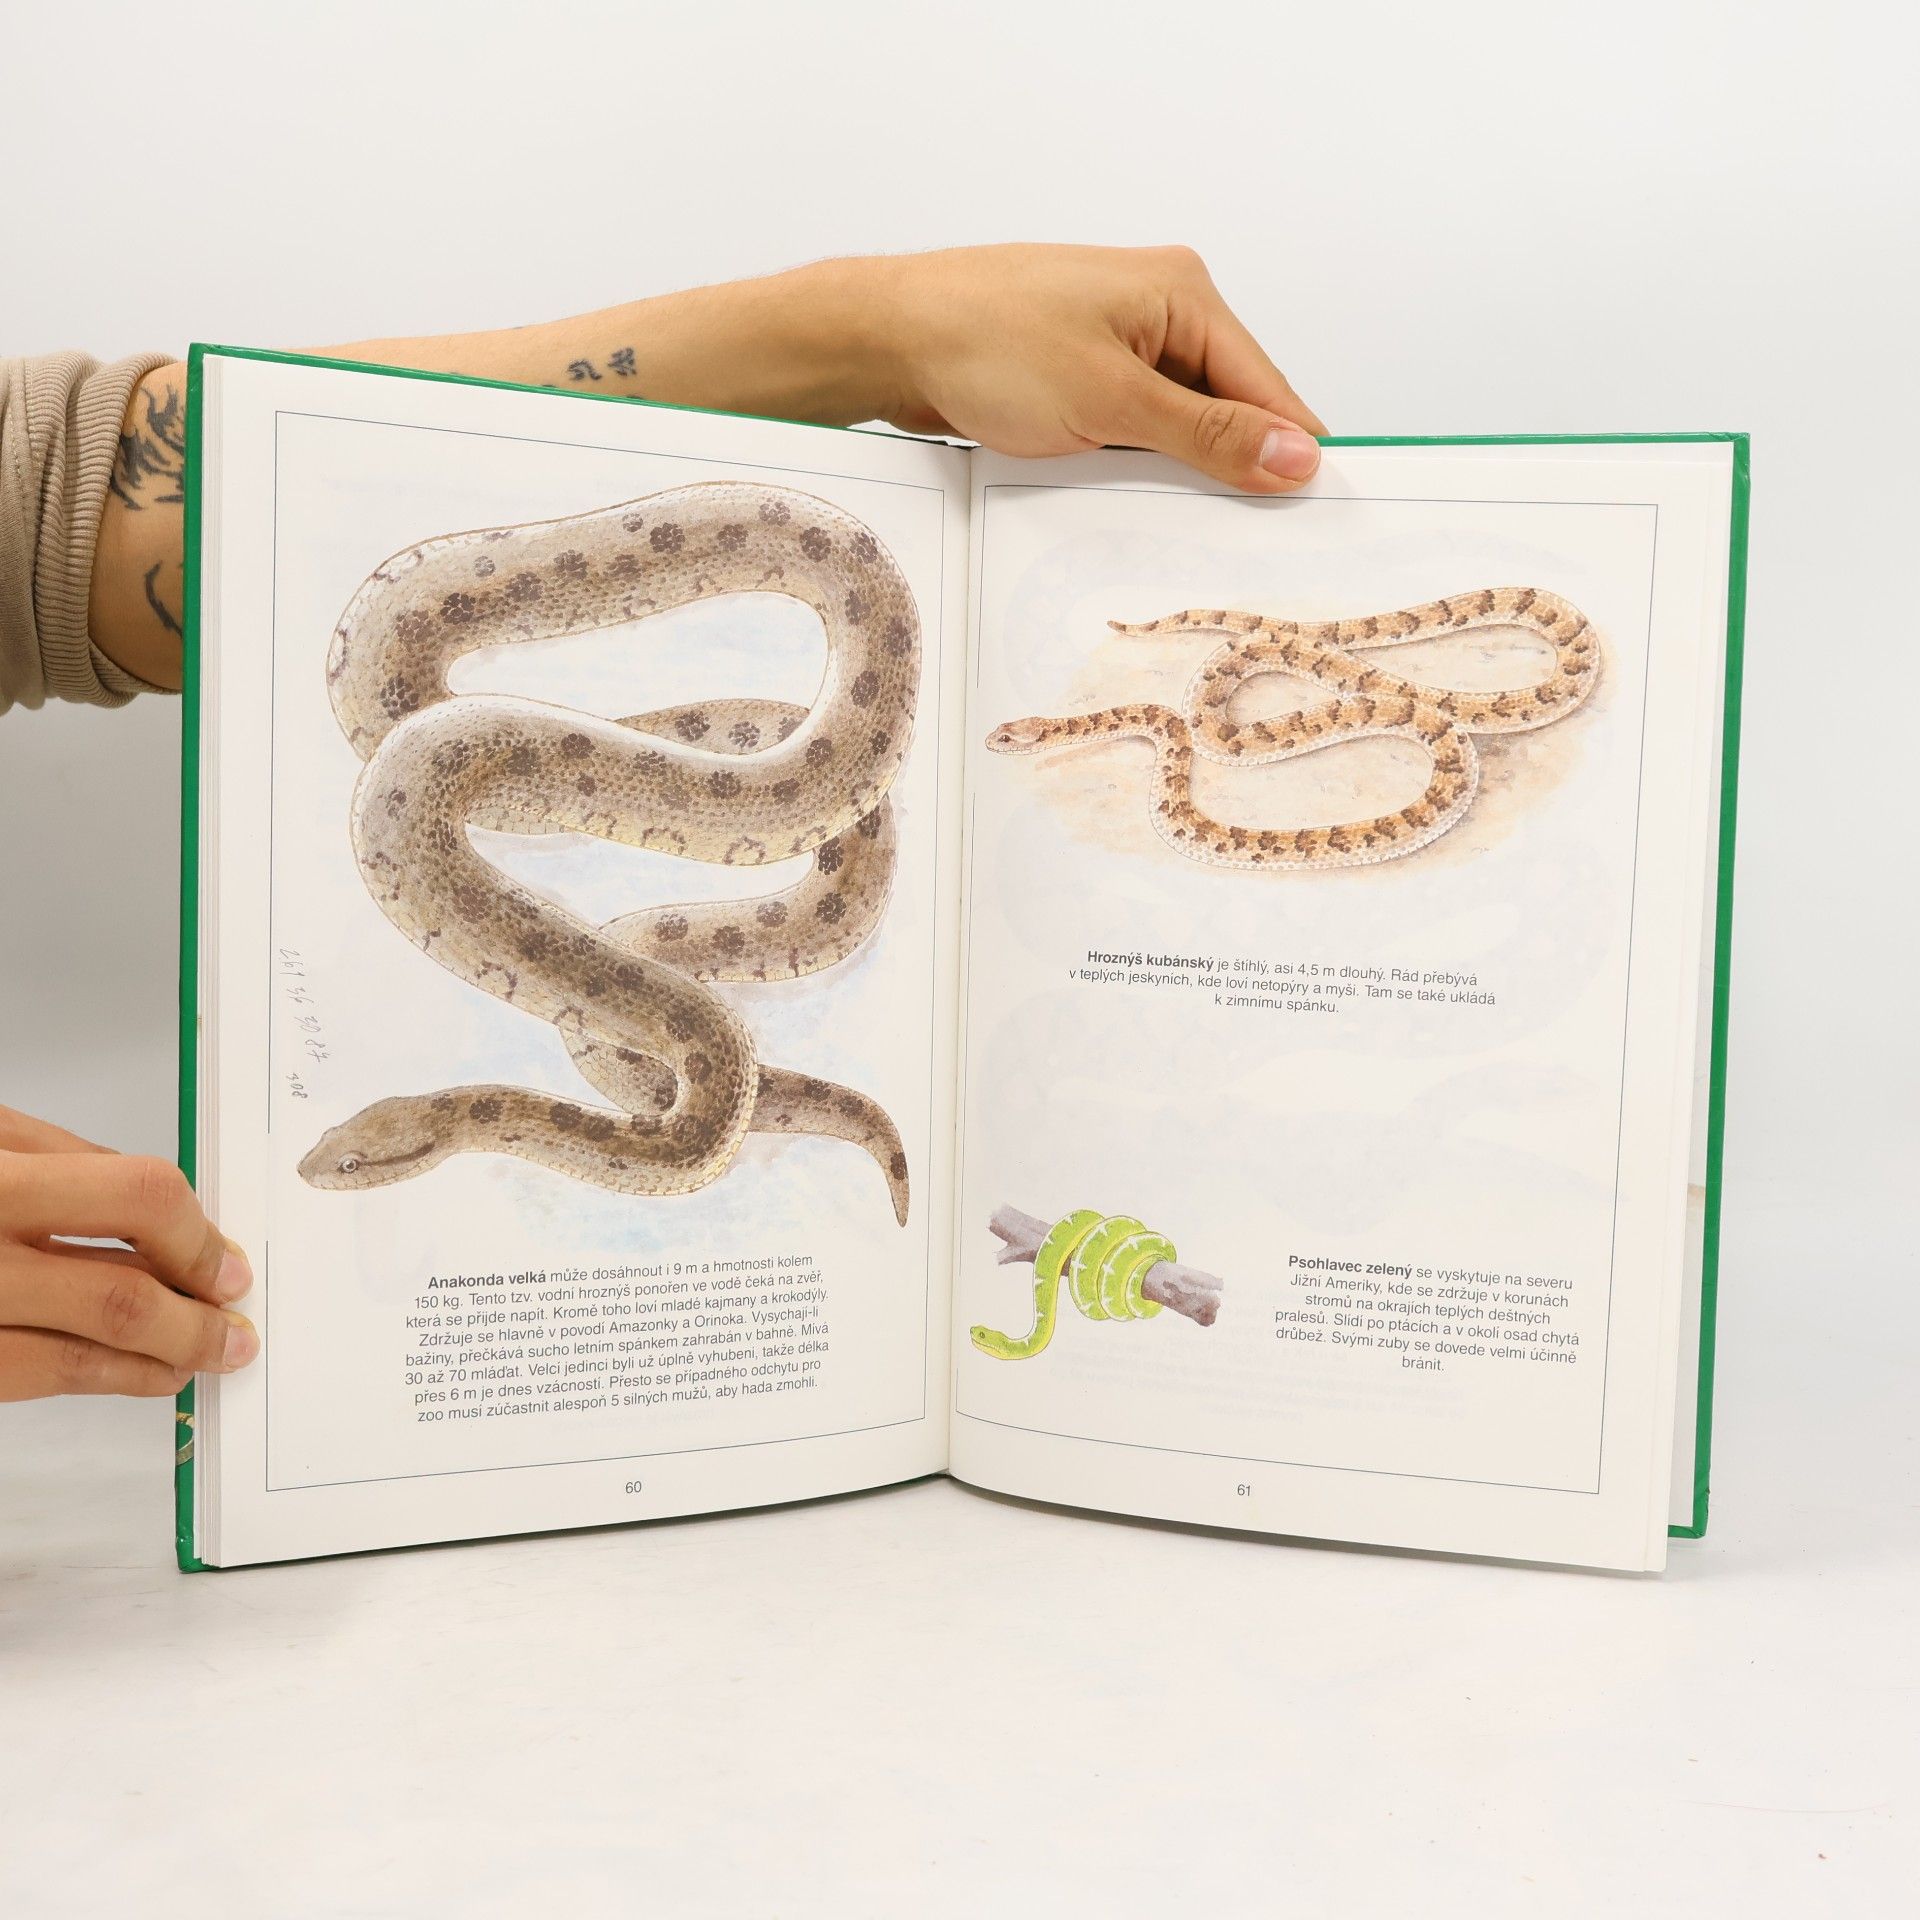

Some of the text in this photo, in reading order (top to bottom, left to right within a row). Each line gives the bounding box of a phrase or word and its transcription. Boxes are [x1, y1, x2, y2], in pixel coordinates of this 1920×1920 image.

[1069, 968, 1496, 1005] v teplých jeskyních, kde loví netopýry a myši. Tam se také ukládá
[1088, 950, 1477, 988] Hroznýš kubánský je štíhlý, asi 4,5 m dlouhý. Rád přebývá
[1215, 993, 1339, 1013] k zimnímu spánku.
[415, 1270, 823, 1310] 150 kg. Tento tzv. vodní hroznýš ponořen ve vodě čeká na zvěř,
[427, 1255, 813, 1289] Anakonda velká může dosáhnout i 9 m a hmotnosti kolem
[1288, 1255, 1573, 1290] Psohlavec zelený se vyskytuje na severu
[1290, 1273, 1568, 1307] Jižní Ameriky, kde se zdržuje v korunách
[406, 1288, 828, 1328] která se přijde napít. Kromě toho loví mladé kajmany a krokodýly.
[419, 1306, 818, 1347] Zdržuje se hlavně v povodí Amazonky a Orinoka. Vysychají-li
[1305, 1294, 1550, 1326] stromů na okrajích teplých deštných
[406, 1321, 829, 1367] bažiny, přečkává sucho letním spánkem zahrabán v bahně. Mívá
[1275, 1310, 1579, 1347] pralesů. Slídí po ptácích a v okolí osad chytá
[1276, 1326, 1577, 1364] drůbež. Svými zuby se dovede velmi účinně
[405, 1340, 829, 1385] 30 až 70 mláďat. Velcí jedinci byli už úplně vyhubeni, takže délka
[1402, 1355, 1444, 1371] bránit.
[415, 1360, 821, 1406] přes 6 m je dnes vzácností. Přesto se případného odchytu pro
[417, 1376, 818, 1422] zoo musí zúčastnit alespoň 5 silných mužů, aby hada zmohli.
[625, 1481, 642, 1493] 60
[1237, 1483, 1250, 1496] 61
